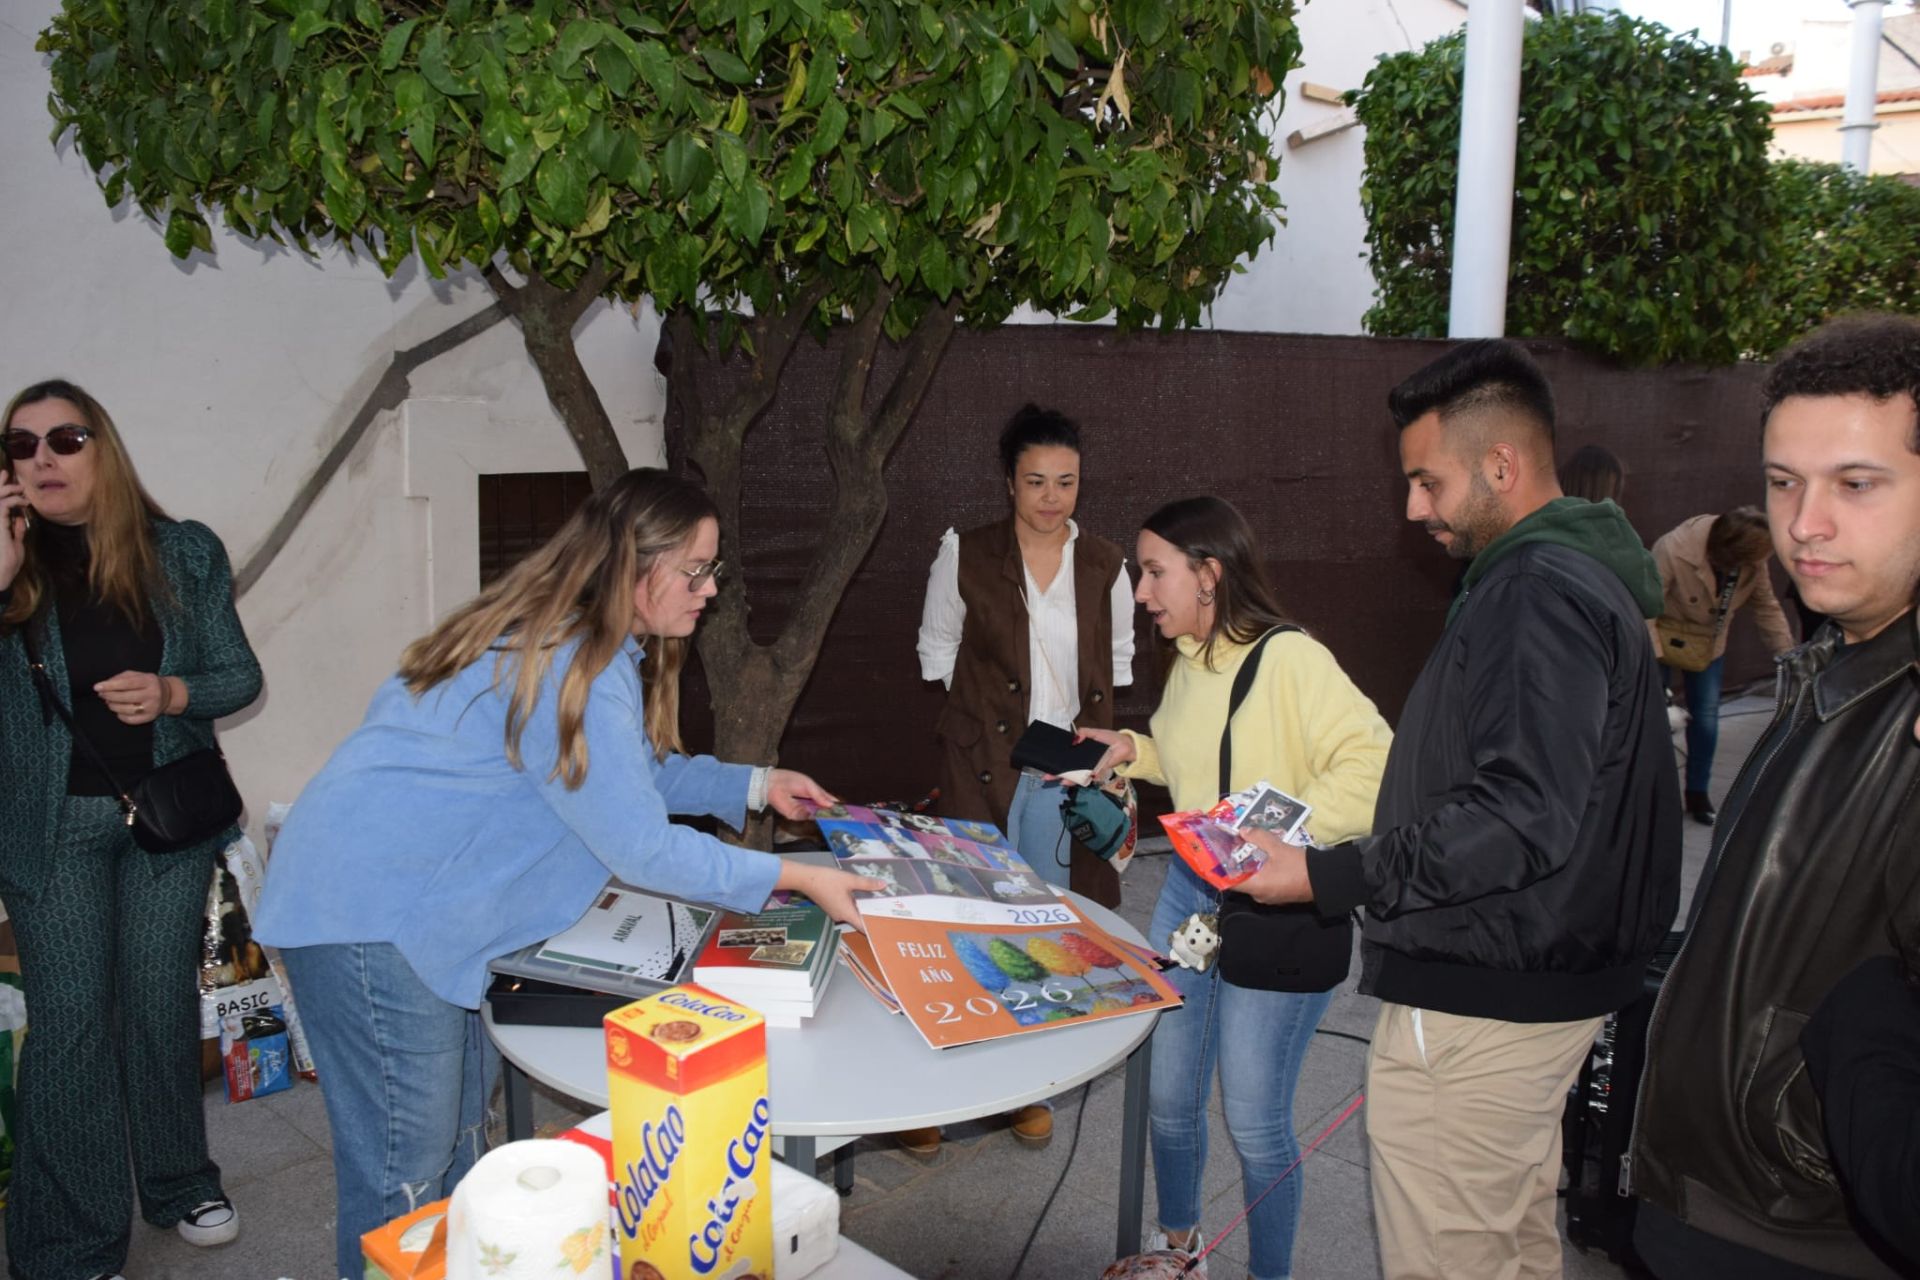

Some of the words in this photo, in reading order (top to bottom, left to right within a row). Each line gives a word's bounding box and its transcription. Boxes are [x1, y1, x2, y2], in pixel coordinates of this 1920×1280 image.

[1007, 908, 1071, 925] 2026
[896, 941, 947, 959] FELIZ
[919, 965, 953, 984] AÑO
[216, 991, 269, 1016] BASIC
[658, 993, 746, 1022] ColaCao
[924, 981, 1073, 1025] 2026
[615, 1105, 684, 1239] ColaCao
